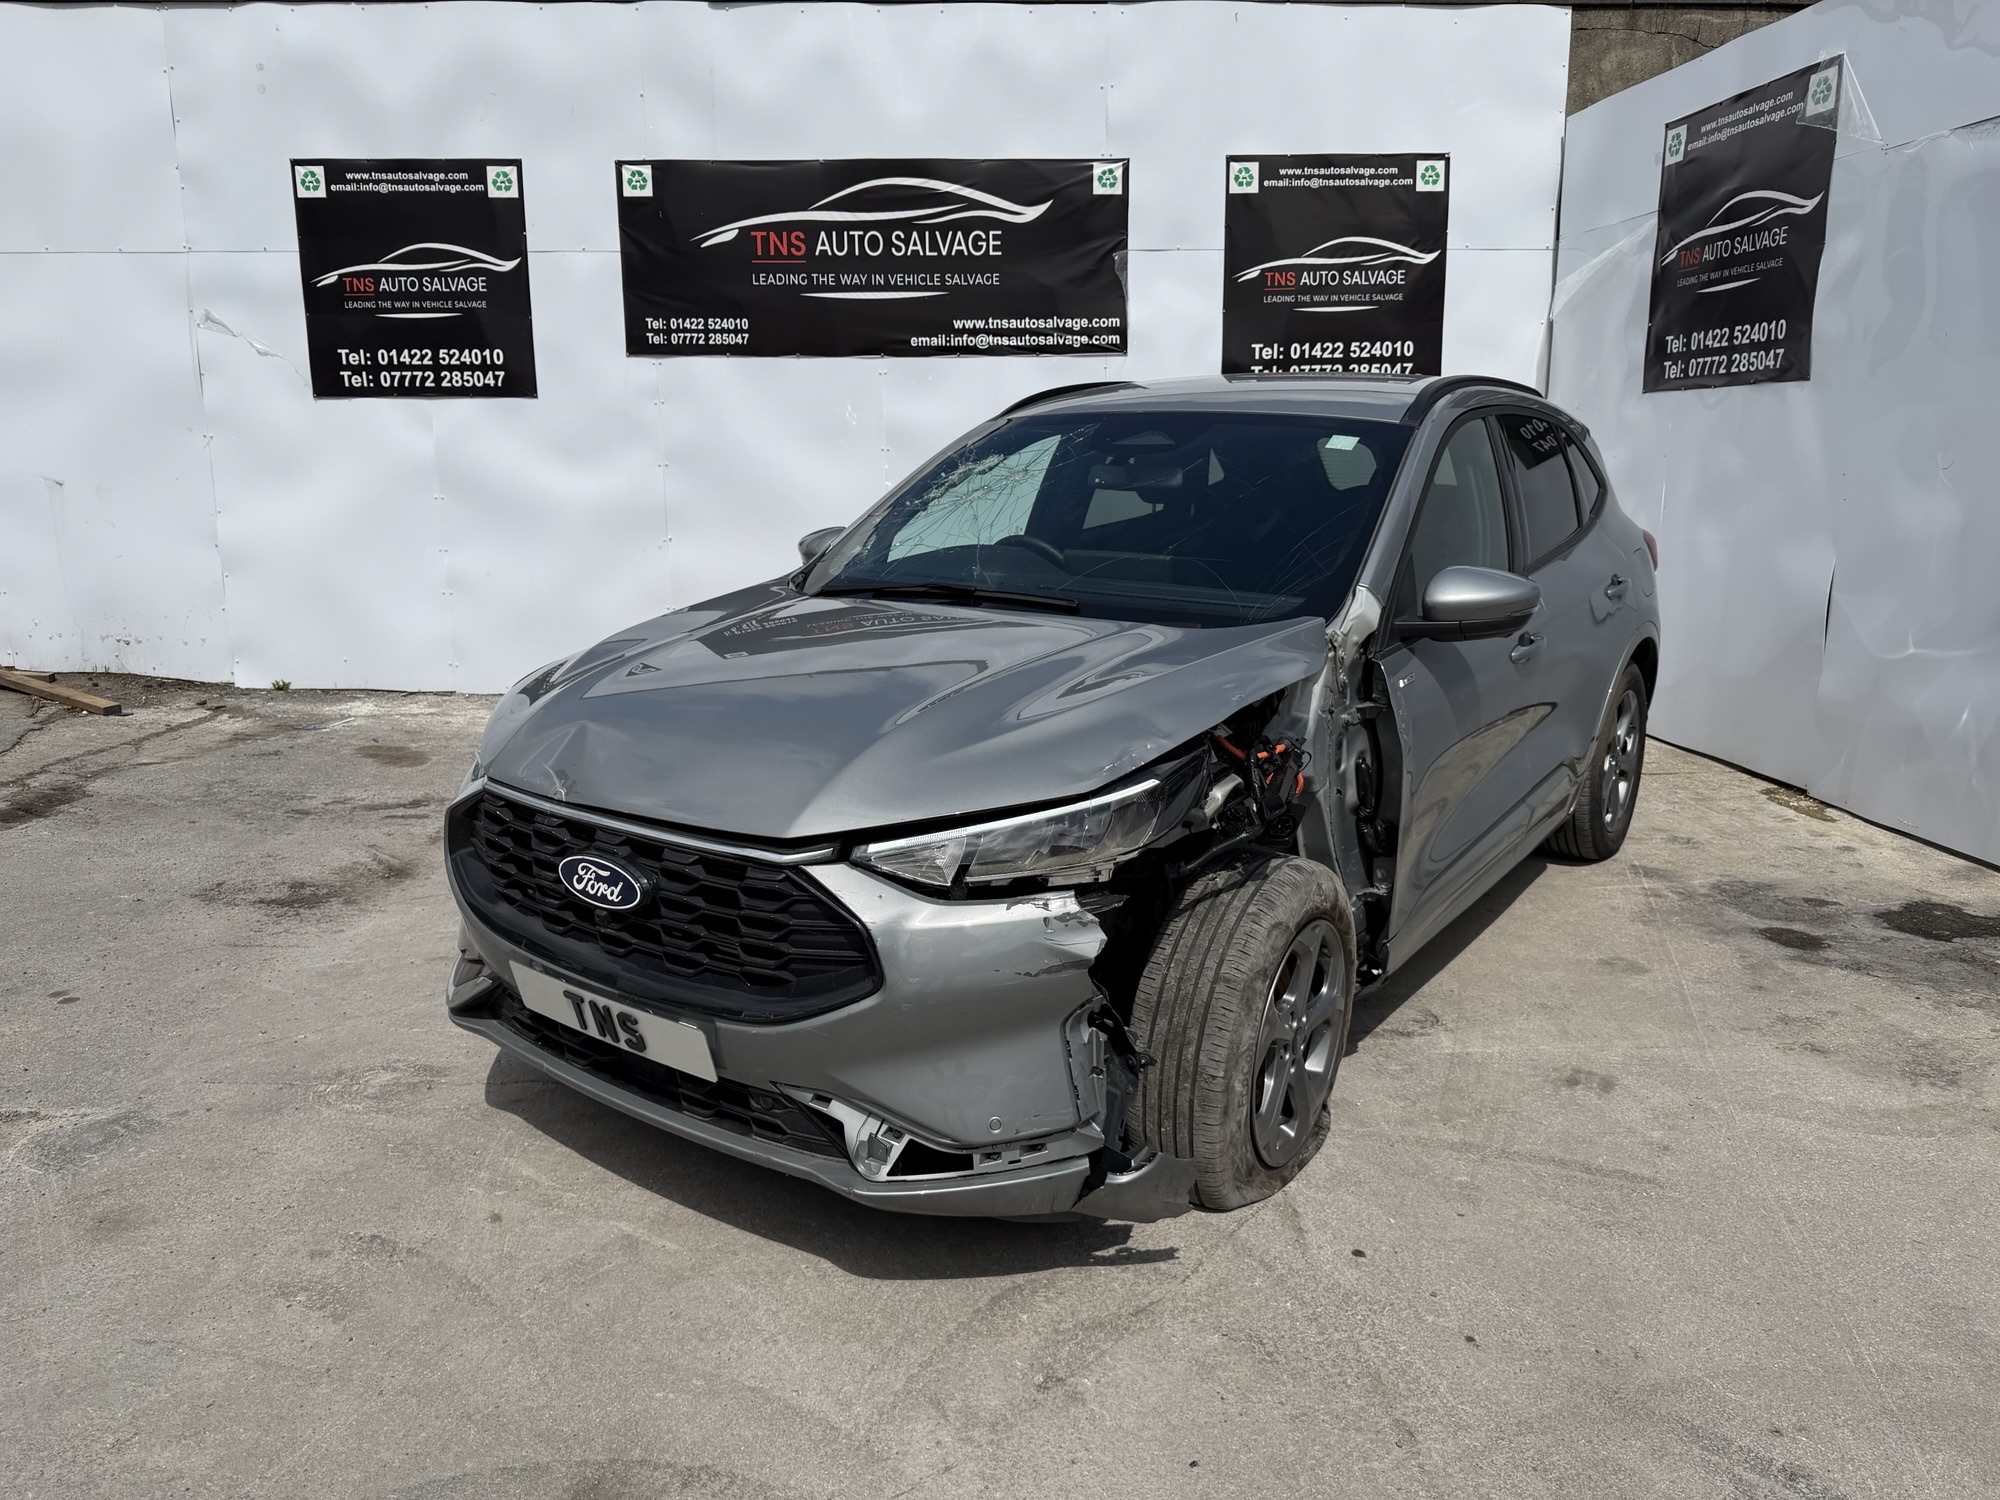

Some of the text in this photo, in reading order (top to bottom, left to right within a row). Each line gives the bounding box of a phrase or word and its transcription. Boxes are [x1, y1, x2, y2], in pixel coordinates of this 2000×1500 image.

[1701, 92, 1794, 133] www.tnsautosalvage.com
[1688, 102, 1804, 151] email:info@tnsautosalvage.com
[346, 172, 468, 182] www.tnsautosalvage.com
[1279, 166, 1398, 176] www.tnsautosalvage.com
[331, 182, 484, 193] email:info@tnsautosalvage.com
[1264, 178, 1413, 188] email:info@tnsautosalvage.com
[751, 231, 1002, 256] TNS AUTO SALVAGE
[1680, 226, 1789, 267] TNS AUTO SALVAGE
[752, 274, 1000, 285] LEADING THE WAY IN VEHICLE SALVAGE
[1265, 270, 1406, 287] TNS AUTO SALVAGE
[1677, 258, 1784, 287] LEADING THE WAY IN VEHICLE SALVAGE
[343, 277, 487, 292] TNS AUTO SALVAGE
[1264, 295, 1296, 303] LEADING
[645, 318, 749, 330] Tel: 01422 524010
[953, 317, 1120, 330] www.tnsautosalvage.com
[646, 333, 749, 345] Tel: 07772 285047
[911, 333, 1120, 349] email:info@tnsautosalvage.com
[1666, 319, 1787, 353] Tel: 01422 524010
[338, 349, 504, 365] Tel: 01422 524010
[1251, 341, 1414, 360] Tel: 01422 524010
[1664, 349, 1785, 379] Tel: 07772 285047
[340, 371, 505, 387] Tel: 07772 285047
[573, 862, 623, 903] Ford
[563, 990, 647, 1053] TNS
